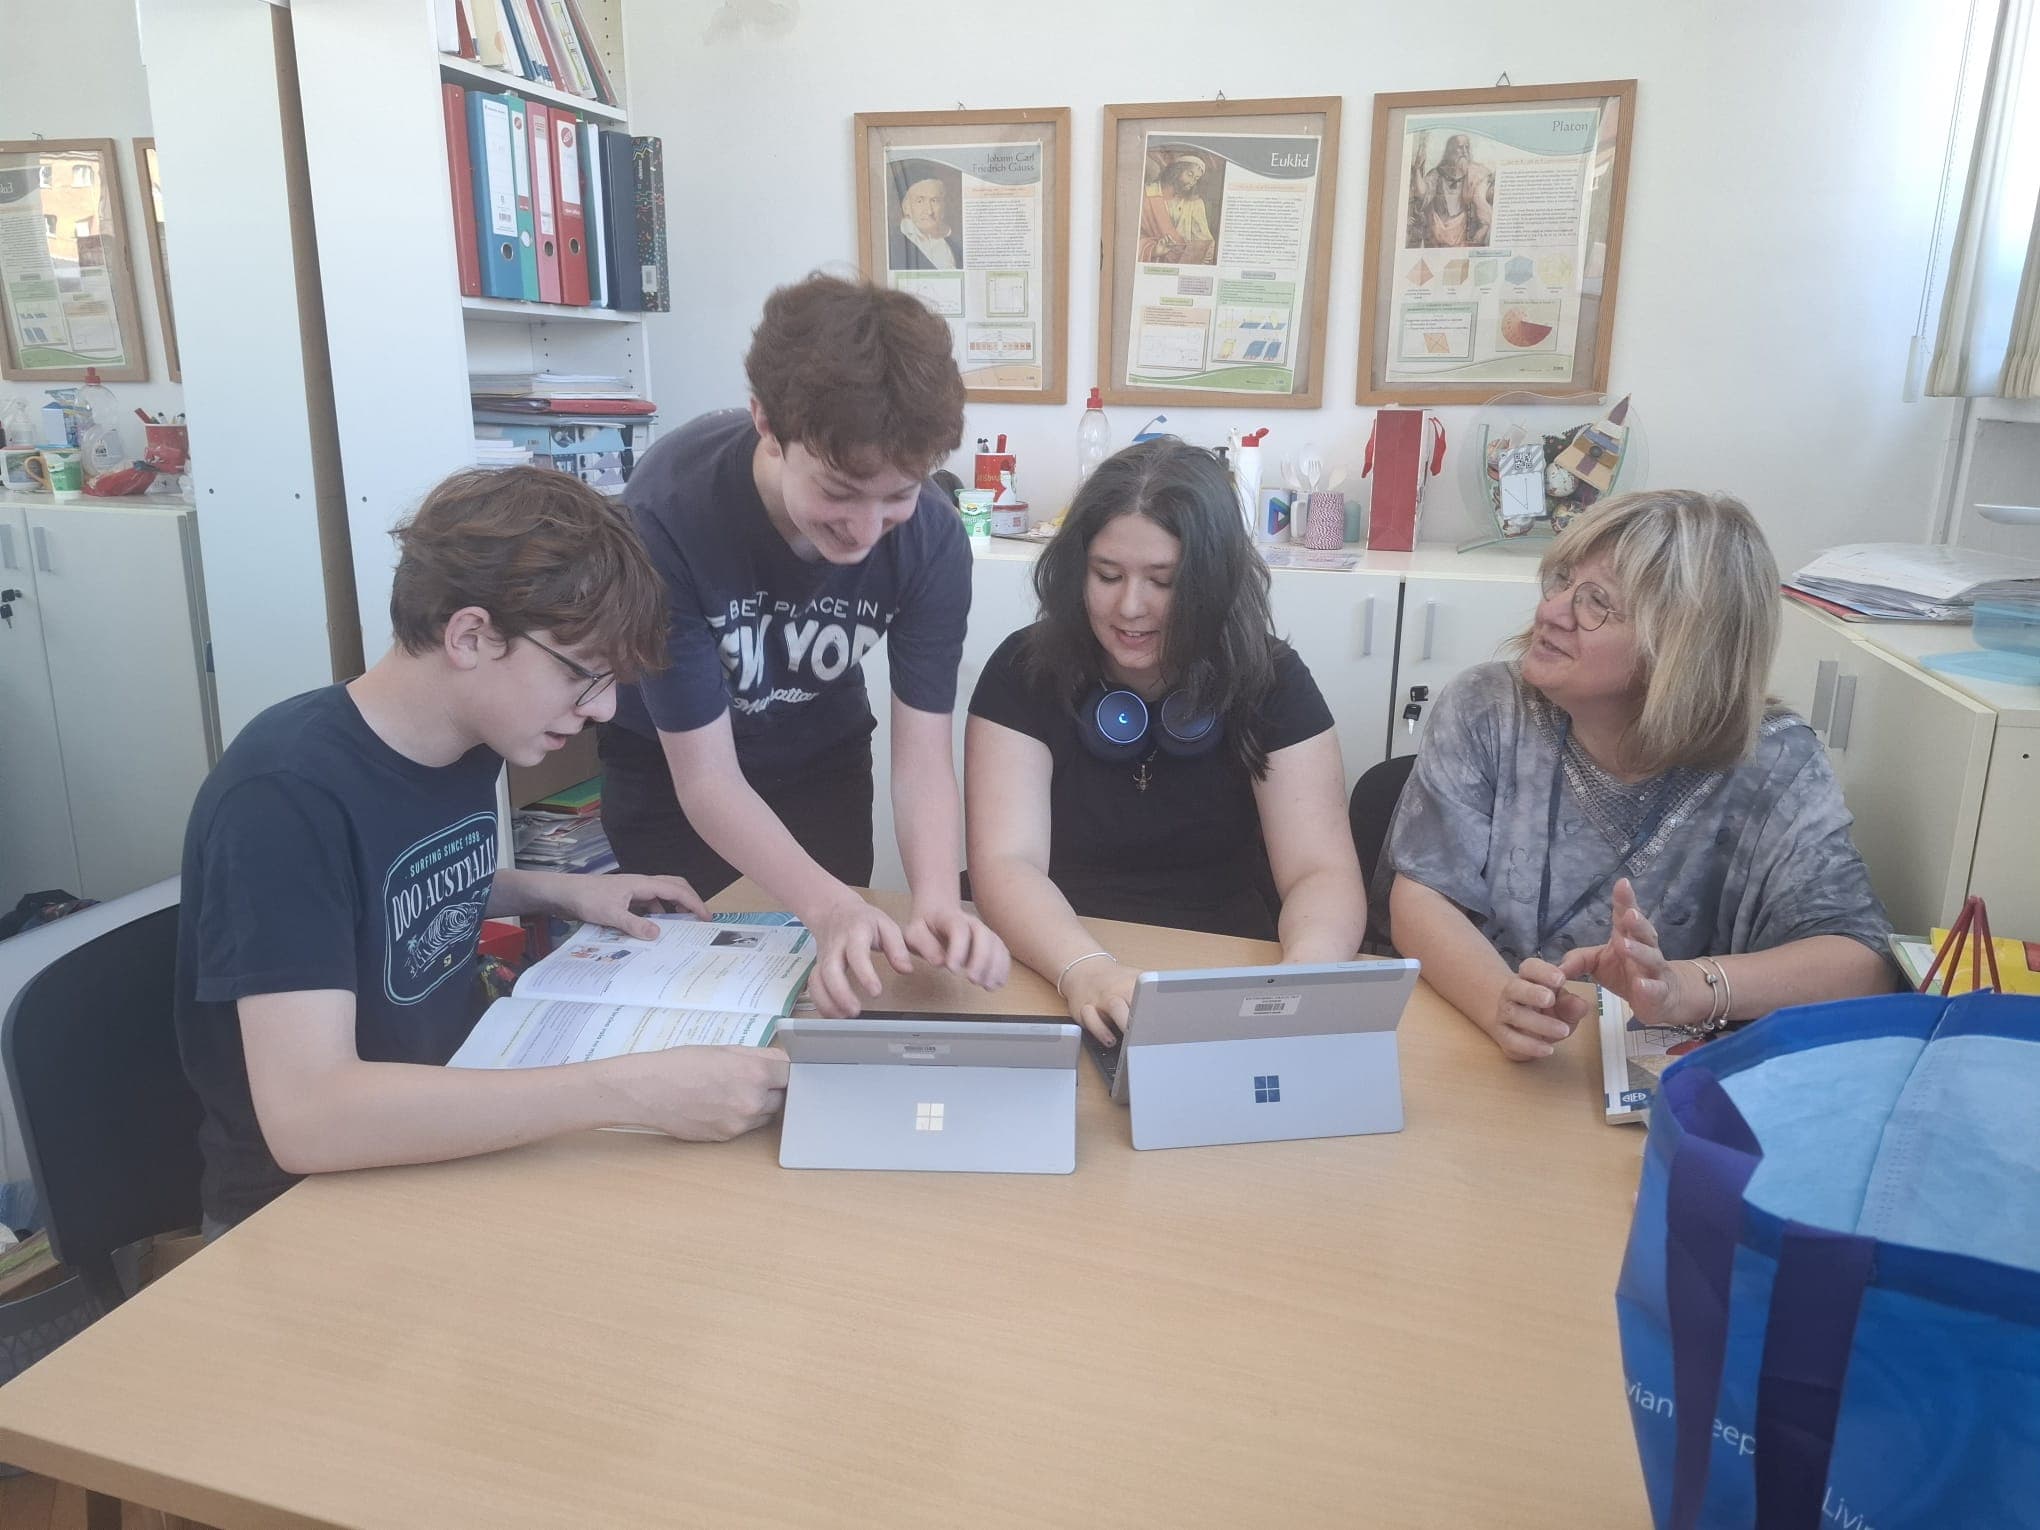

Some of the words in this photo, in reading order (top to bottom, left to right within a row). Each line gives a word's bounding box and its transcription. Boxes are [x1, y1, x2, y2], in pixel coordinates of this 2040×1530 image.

[1552, 120, 1589, 132] Platon
[985, 152, 1013, 163] Johann
[1015, 151, 1035, 162] Carl
[1271, 152, 1310, 168] Euklid
[972, 162, 1006, 173] Friedrich
[1008, 161, 1035, 172] Gauss
[774, 596, 849, 619] PLACE
[857, 599, 878, 619] IN
[783, 618, 881, 682] YOR
[410, 848, 442, 878] SURFING
[443, 838, 464, 857] SINCE
[392, 883, 422, 942] DOO
